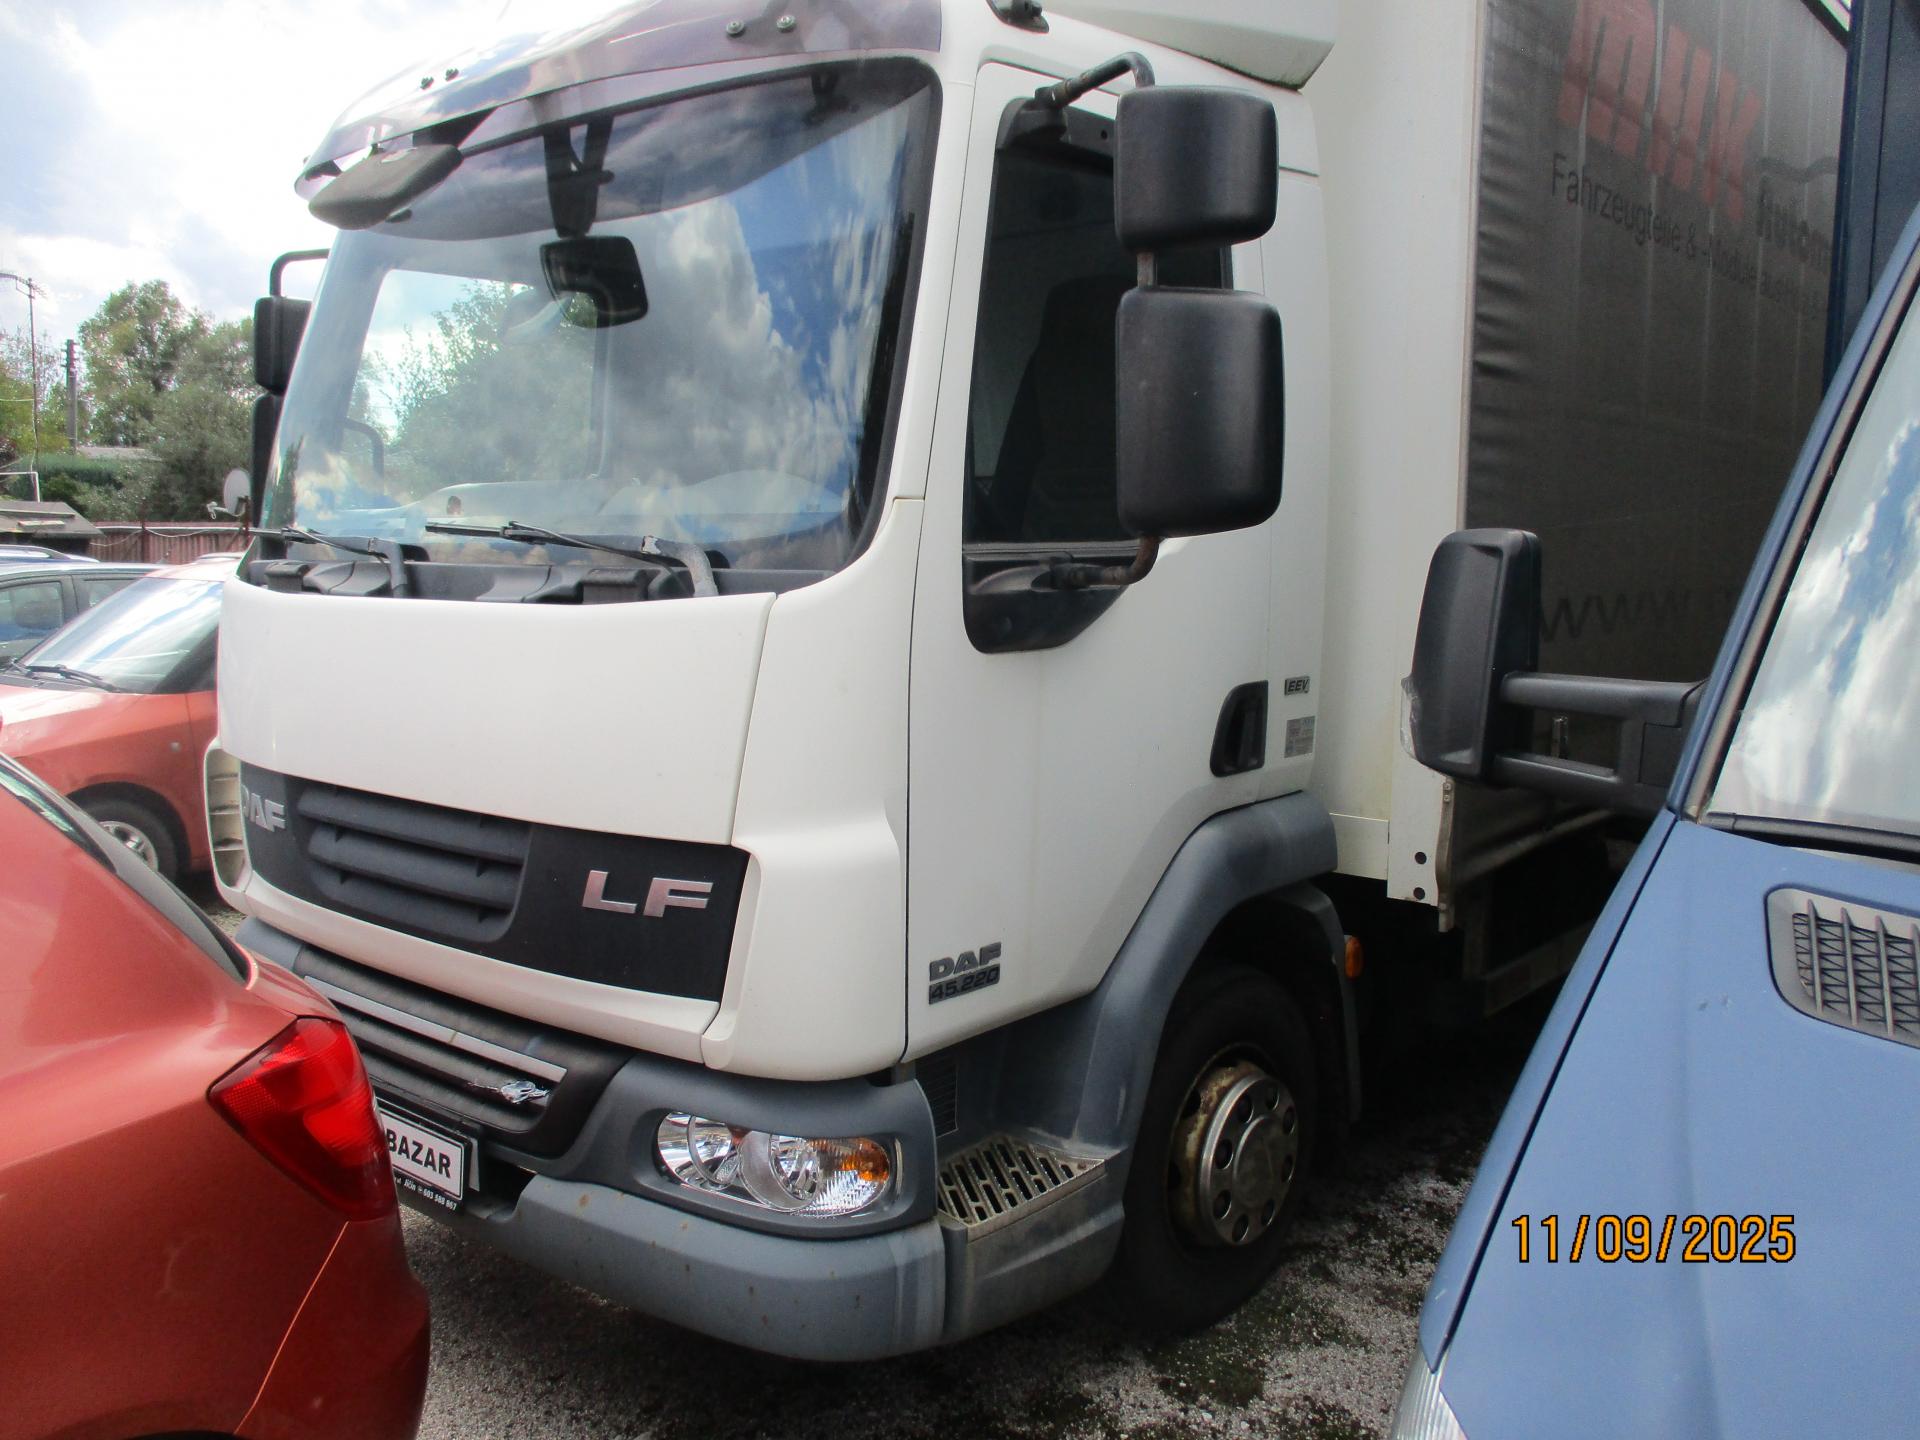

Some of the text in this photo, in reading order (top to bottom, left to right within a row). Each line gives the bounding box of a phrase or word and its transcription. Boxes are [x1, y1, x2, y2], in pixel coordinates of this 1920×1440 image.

[1287, 679, 1309, 693] EEV
[582, 869, 713, 918] LF
[929, 941, 1001, 982] DAF
[930, 964, 1000, 1003] 45.220
[386, 1128, 451, 1178] BAZAR
